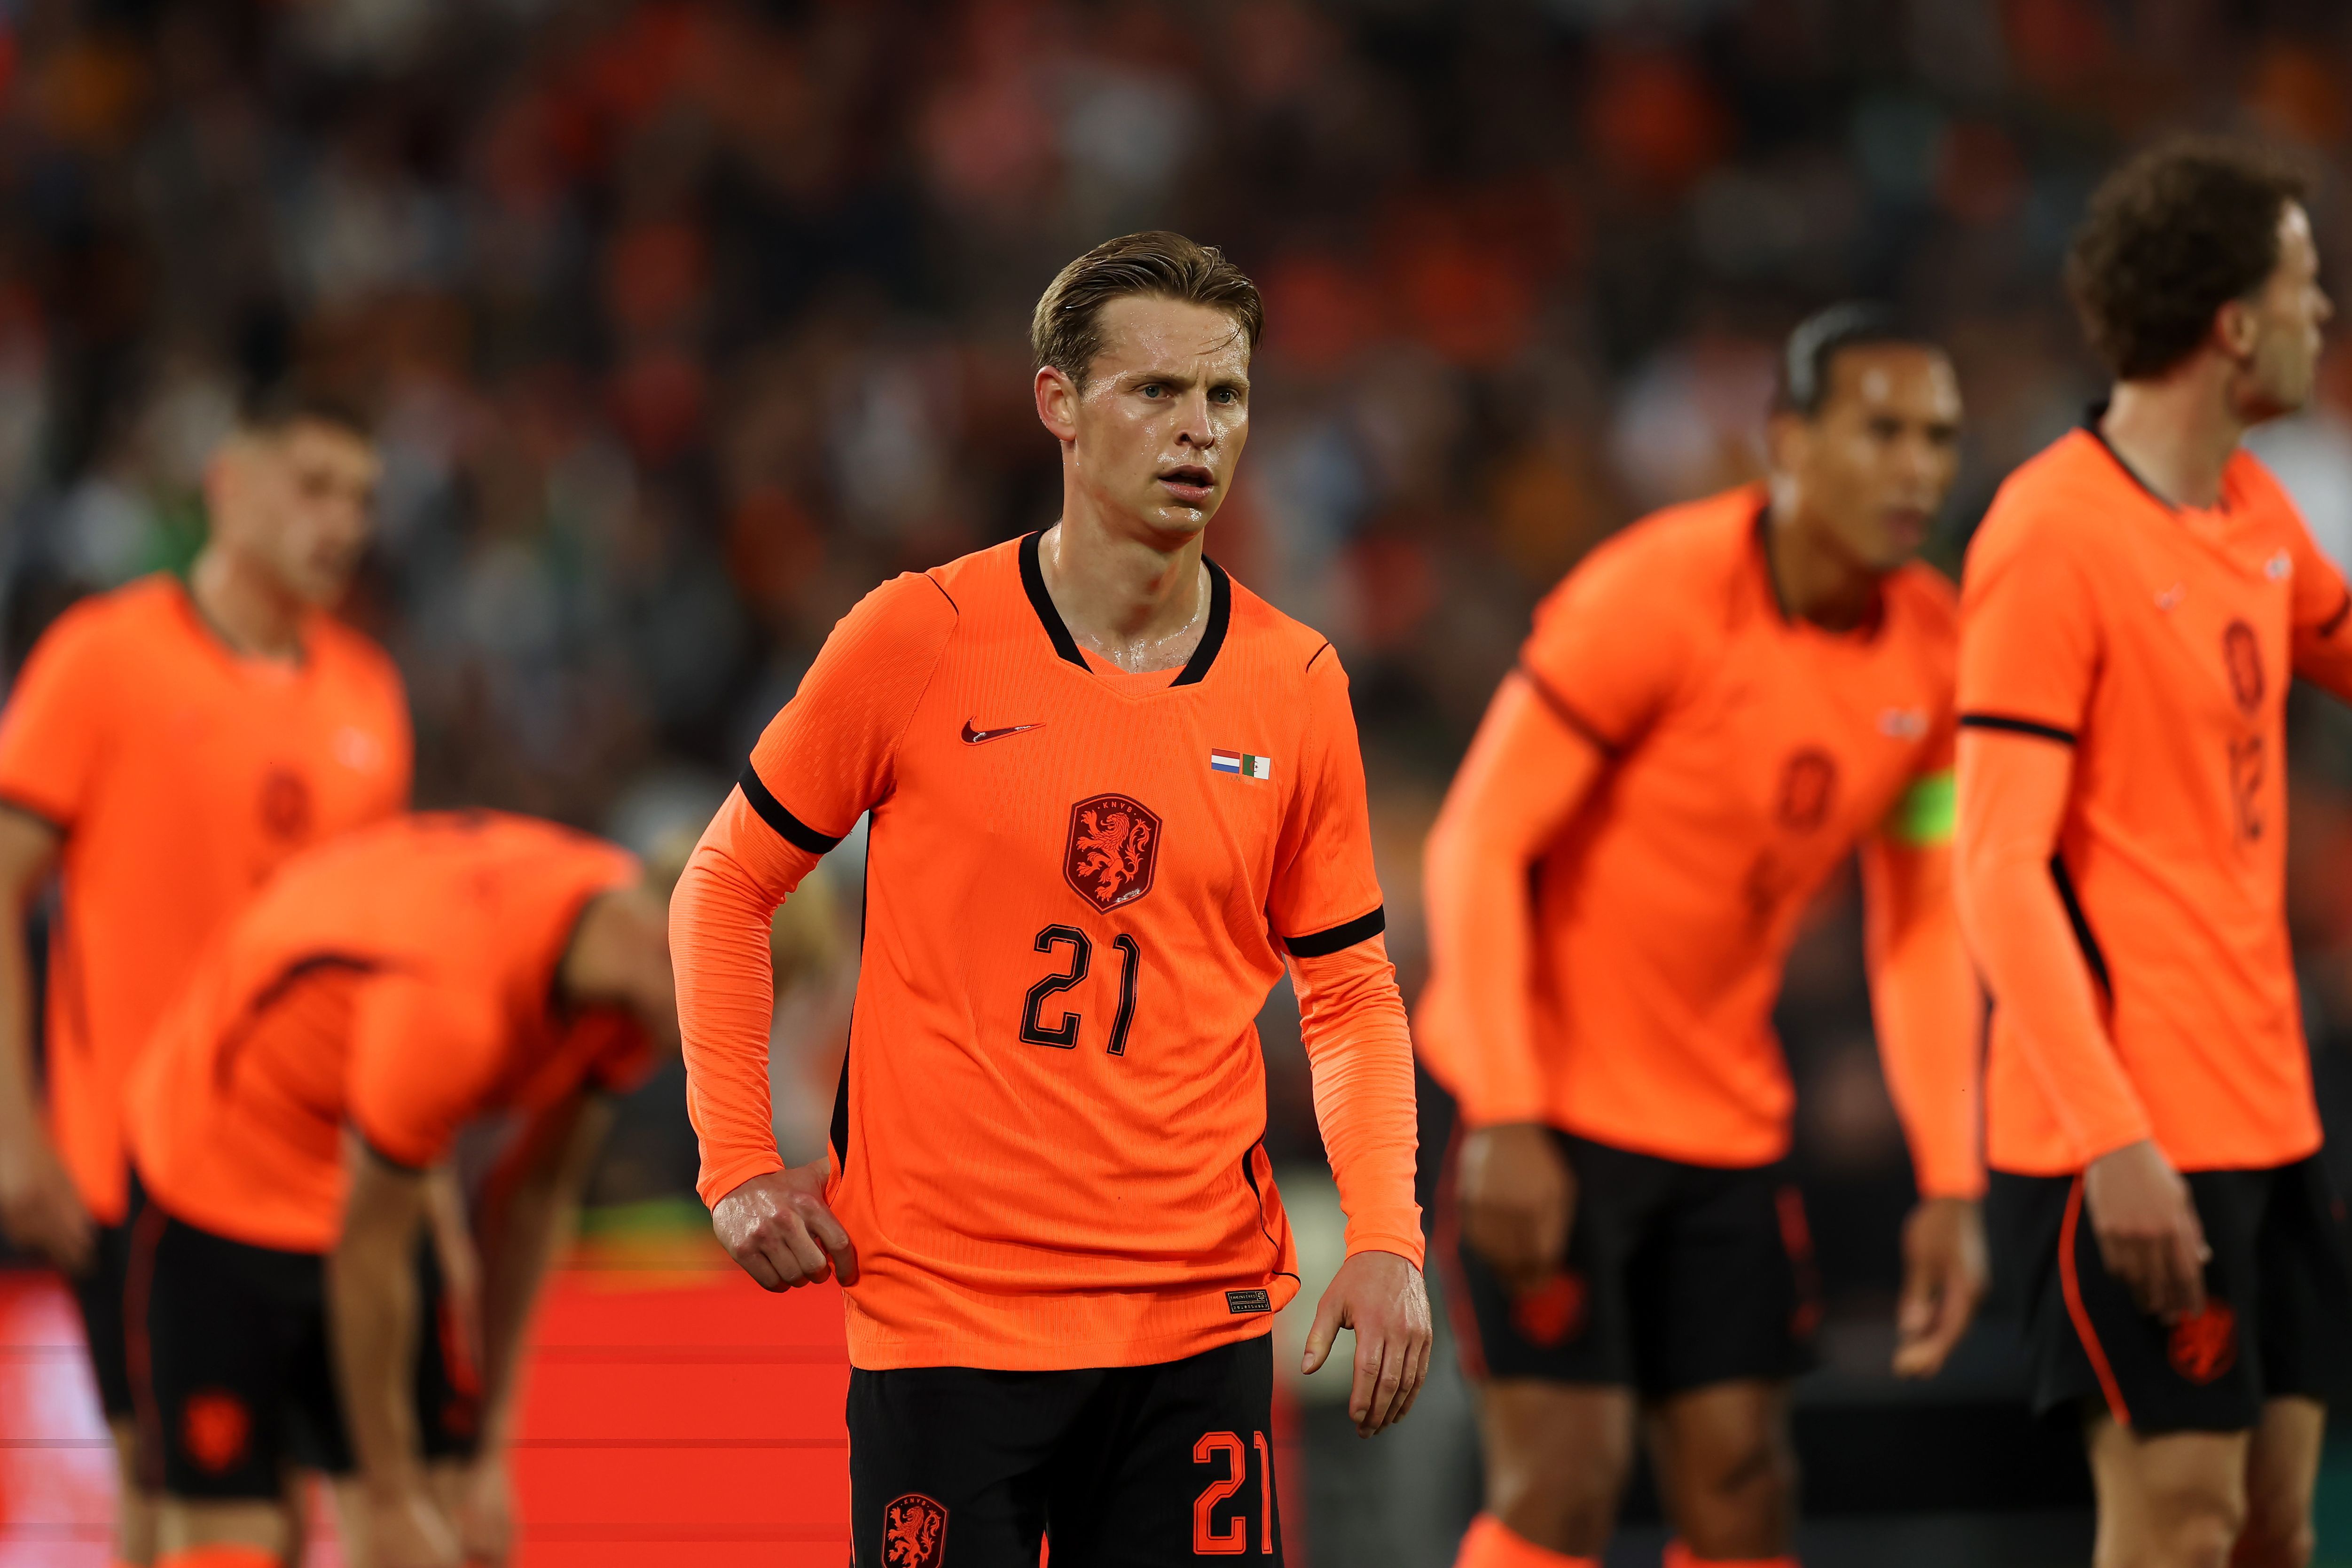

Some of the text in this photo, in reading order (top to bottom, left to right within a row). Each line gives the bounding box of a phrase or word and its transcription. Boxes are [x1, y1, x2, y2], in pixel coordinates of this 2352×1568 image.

[1103, 801, 1132, 812] KNVB
[1019, 924, 1141, 1057] 21
[1193, 1430, 1273, 1555] 21
